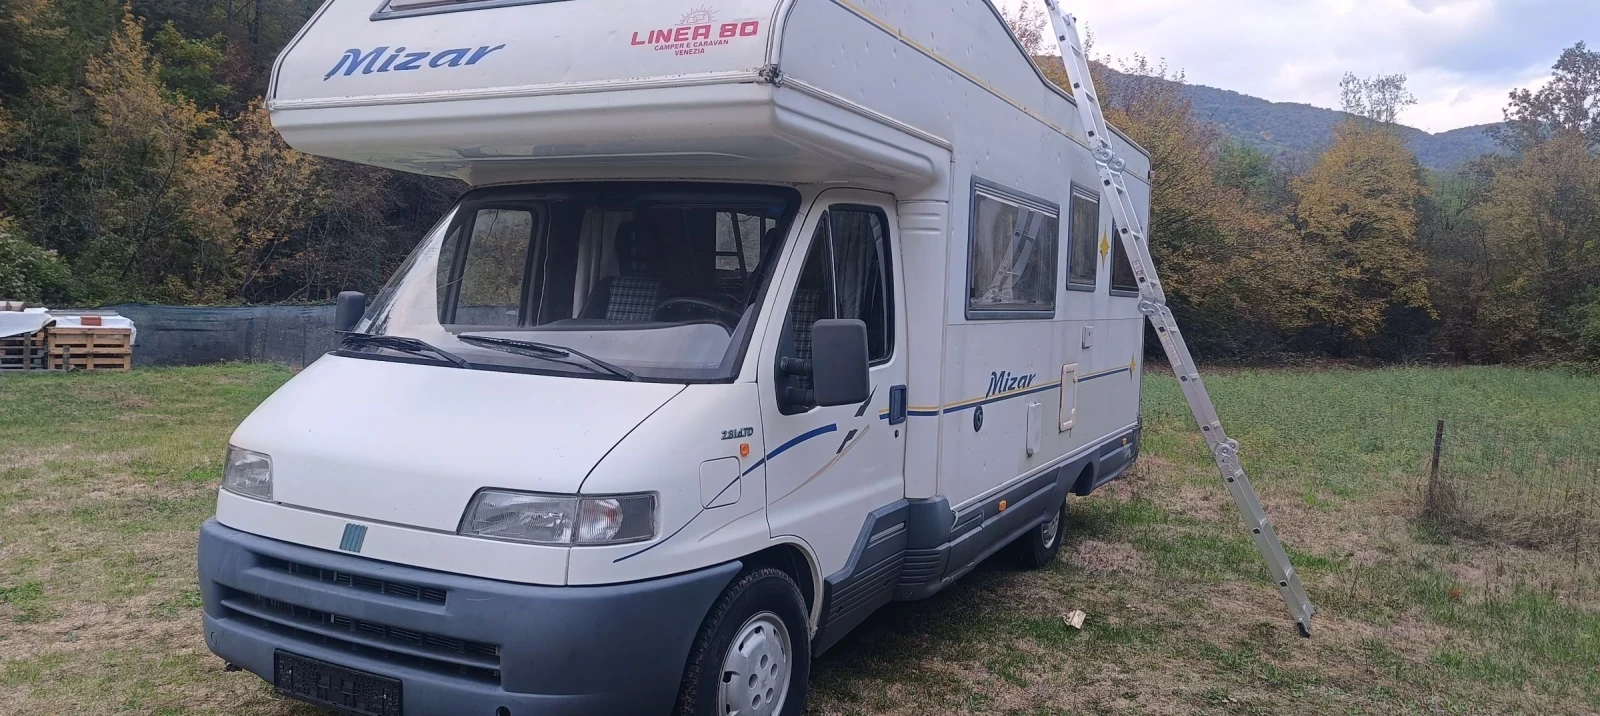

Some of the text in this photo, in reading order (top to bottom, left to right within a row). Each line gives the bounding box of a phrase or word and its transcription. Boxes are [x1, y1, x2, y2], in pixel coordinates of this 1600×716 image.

[631, 21, 759, 46] LINEA 80
[654, 42, 685, 51] CAMPER
[693, 39, 729, 48] CARAVAN
[323, 43, 507, 82] Mizar
[674, 48, 705, 56] VENEZIA
[985, 370, 1036, 399] Mizar
